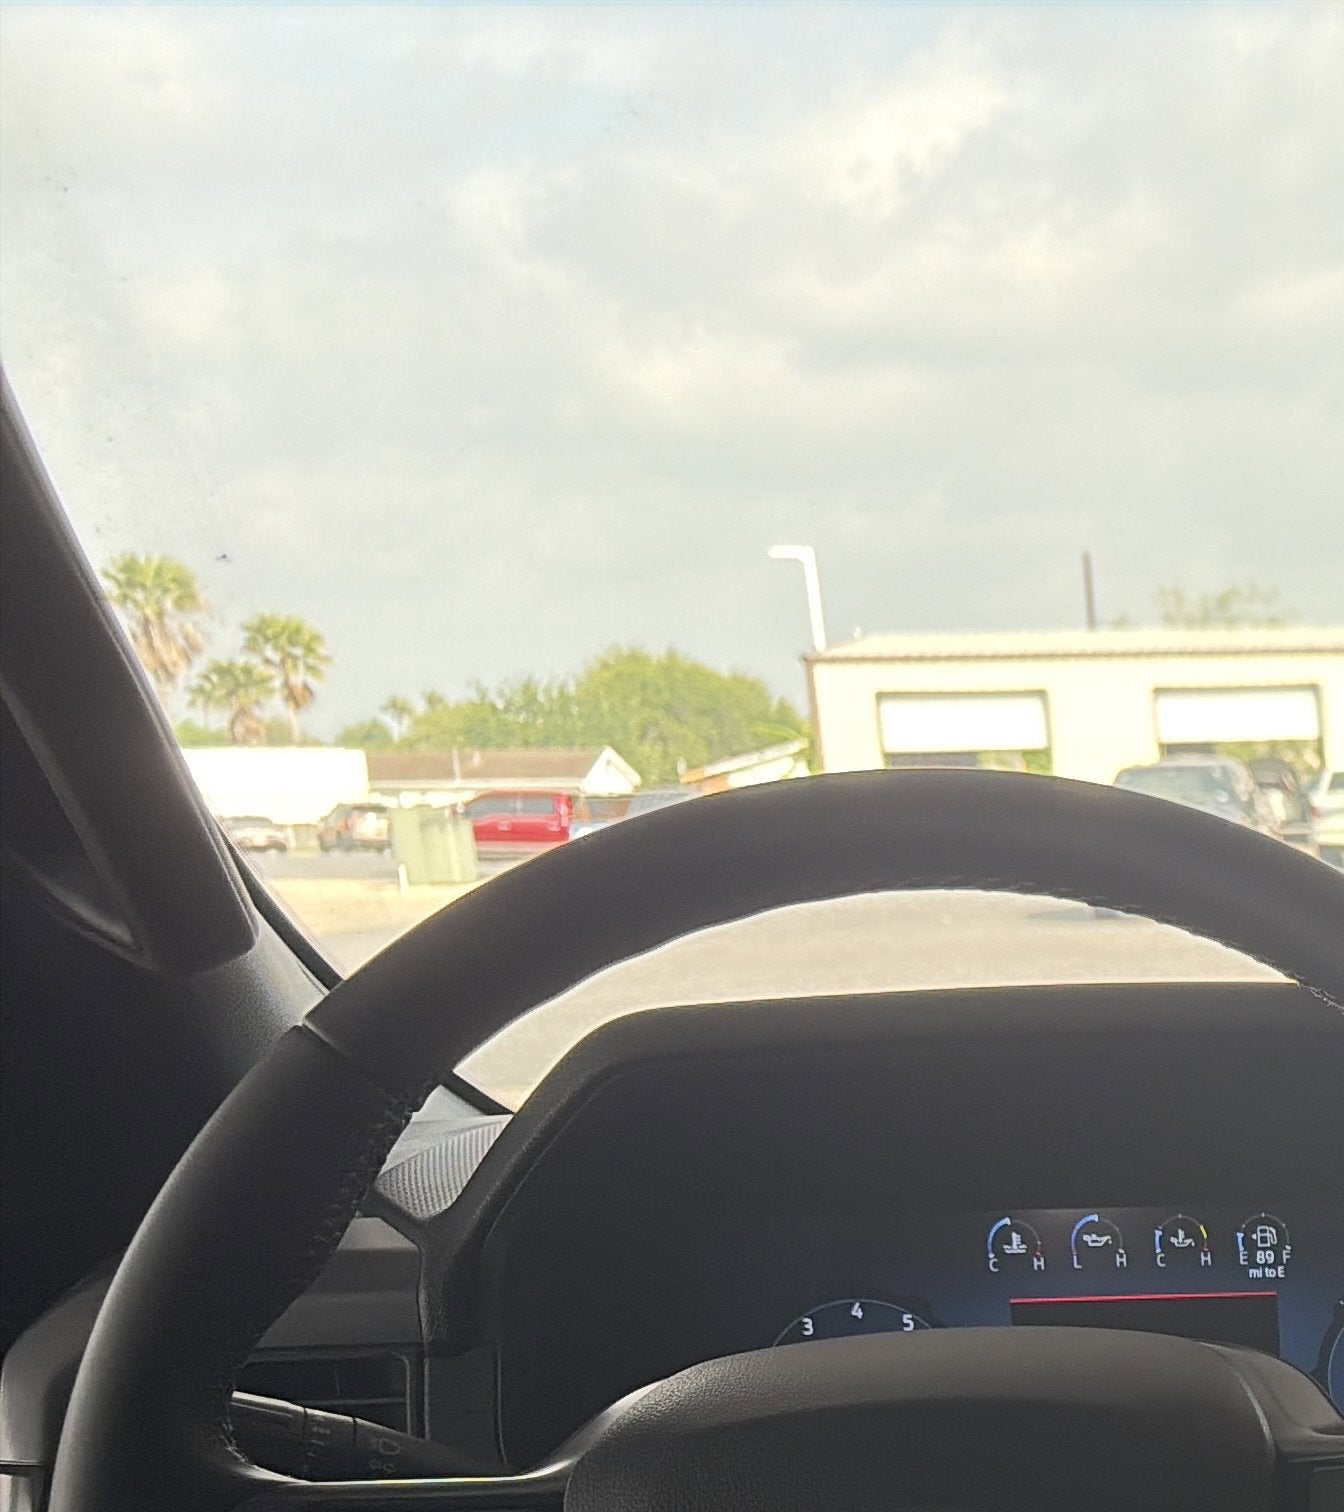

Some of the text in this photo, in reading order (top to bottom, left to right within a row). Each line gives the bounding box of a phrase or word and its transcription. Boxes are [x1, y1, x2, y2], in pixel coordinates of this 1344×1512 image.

[1256, 1250, 1275, 1265] 89
[851, 1302, 864, 1319] 4
[801, 1317, 815, 1336] 3
[902, 1313, 915, 1332] 5
